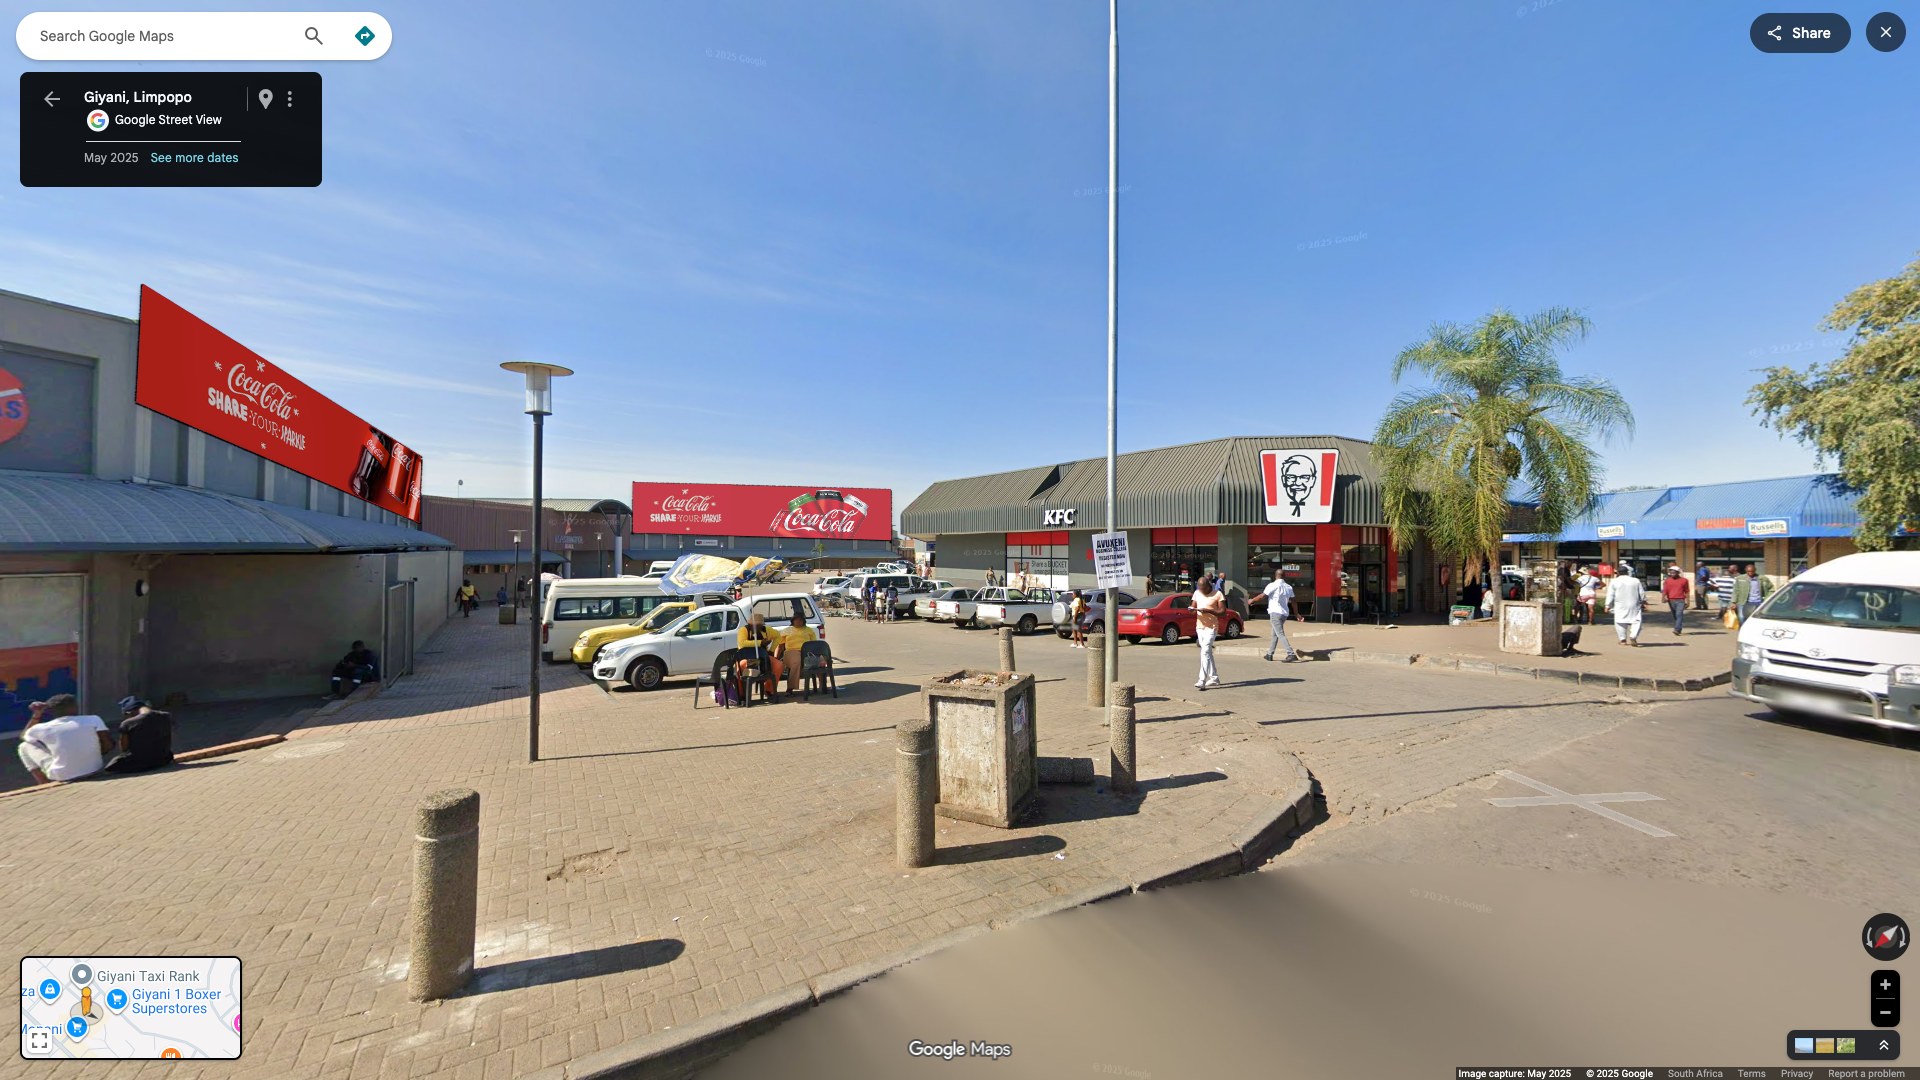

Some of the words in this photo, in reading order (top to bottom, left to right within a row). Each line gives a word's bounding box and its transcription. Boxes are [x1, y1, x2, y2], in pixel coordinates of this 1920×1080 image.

[227, 363, 297, 420] Coca-Cola
[207, 386, 249, 422] SHARE
[661, 495, 716, 512] Coca-Cola
[650, 513, 677, 523] SHARE
[783, 507, 859, 533] Coca-Cola
[1043, 508, 1076, 525] KFC
[1750, 522, 1785, 532] Russells
[1096, 538, 1126, 549] AVUXENI
